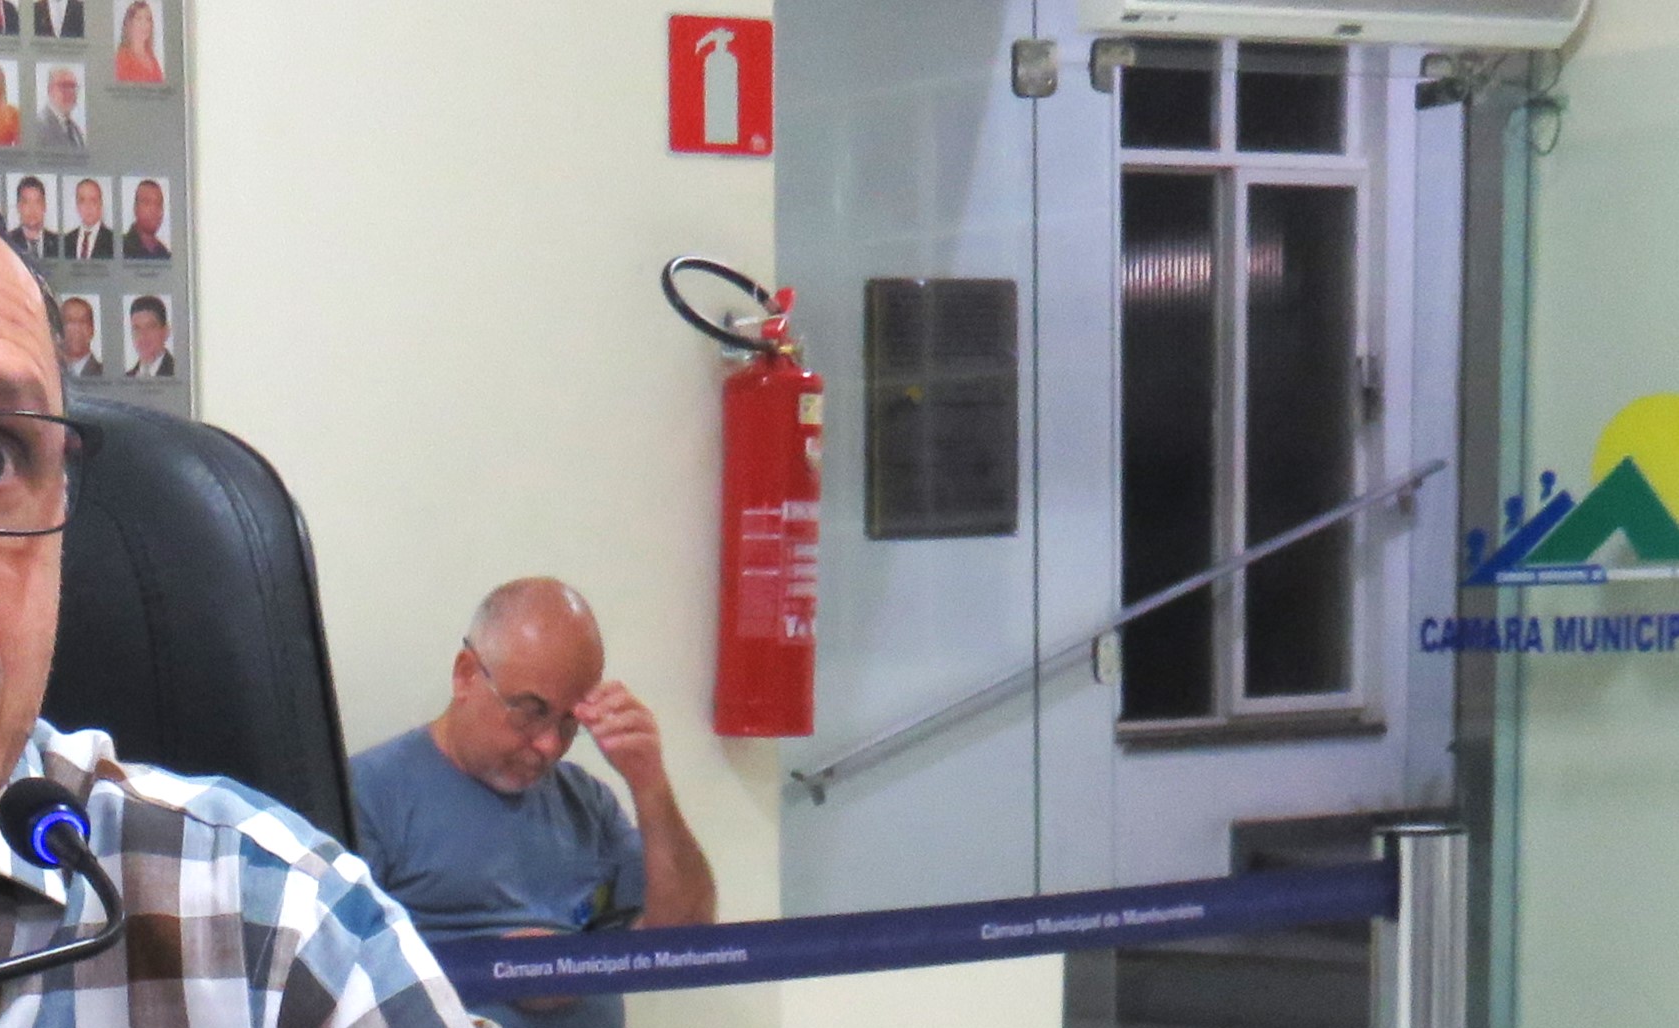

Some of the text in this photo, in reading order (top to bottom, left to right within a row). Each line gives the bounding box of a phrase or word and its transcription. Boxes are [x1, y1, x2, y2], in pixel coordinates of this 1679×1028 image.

[1036, 914, 1102, 935] Municipal
[1103, 912, 1121, 928] de
[1122, 904, 1205, 925] Manhumirim
[556, 953, 630, 975] Municipal
[633, 953, 652, 971] de
[654, 947, 748, 968] Manhumirim
